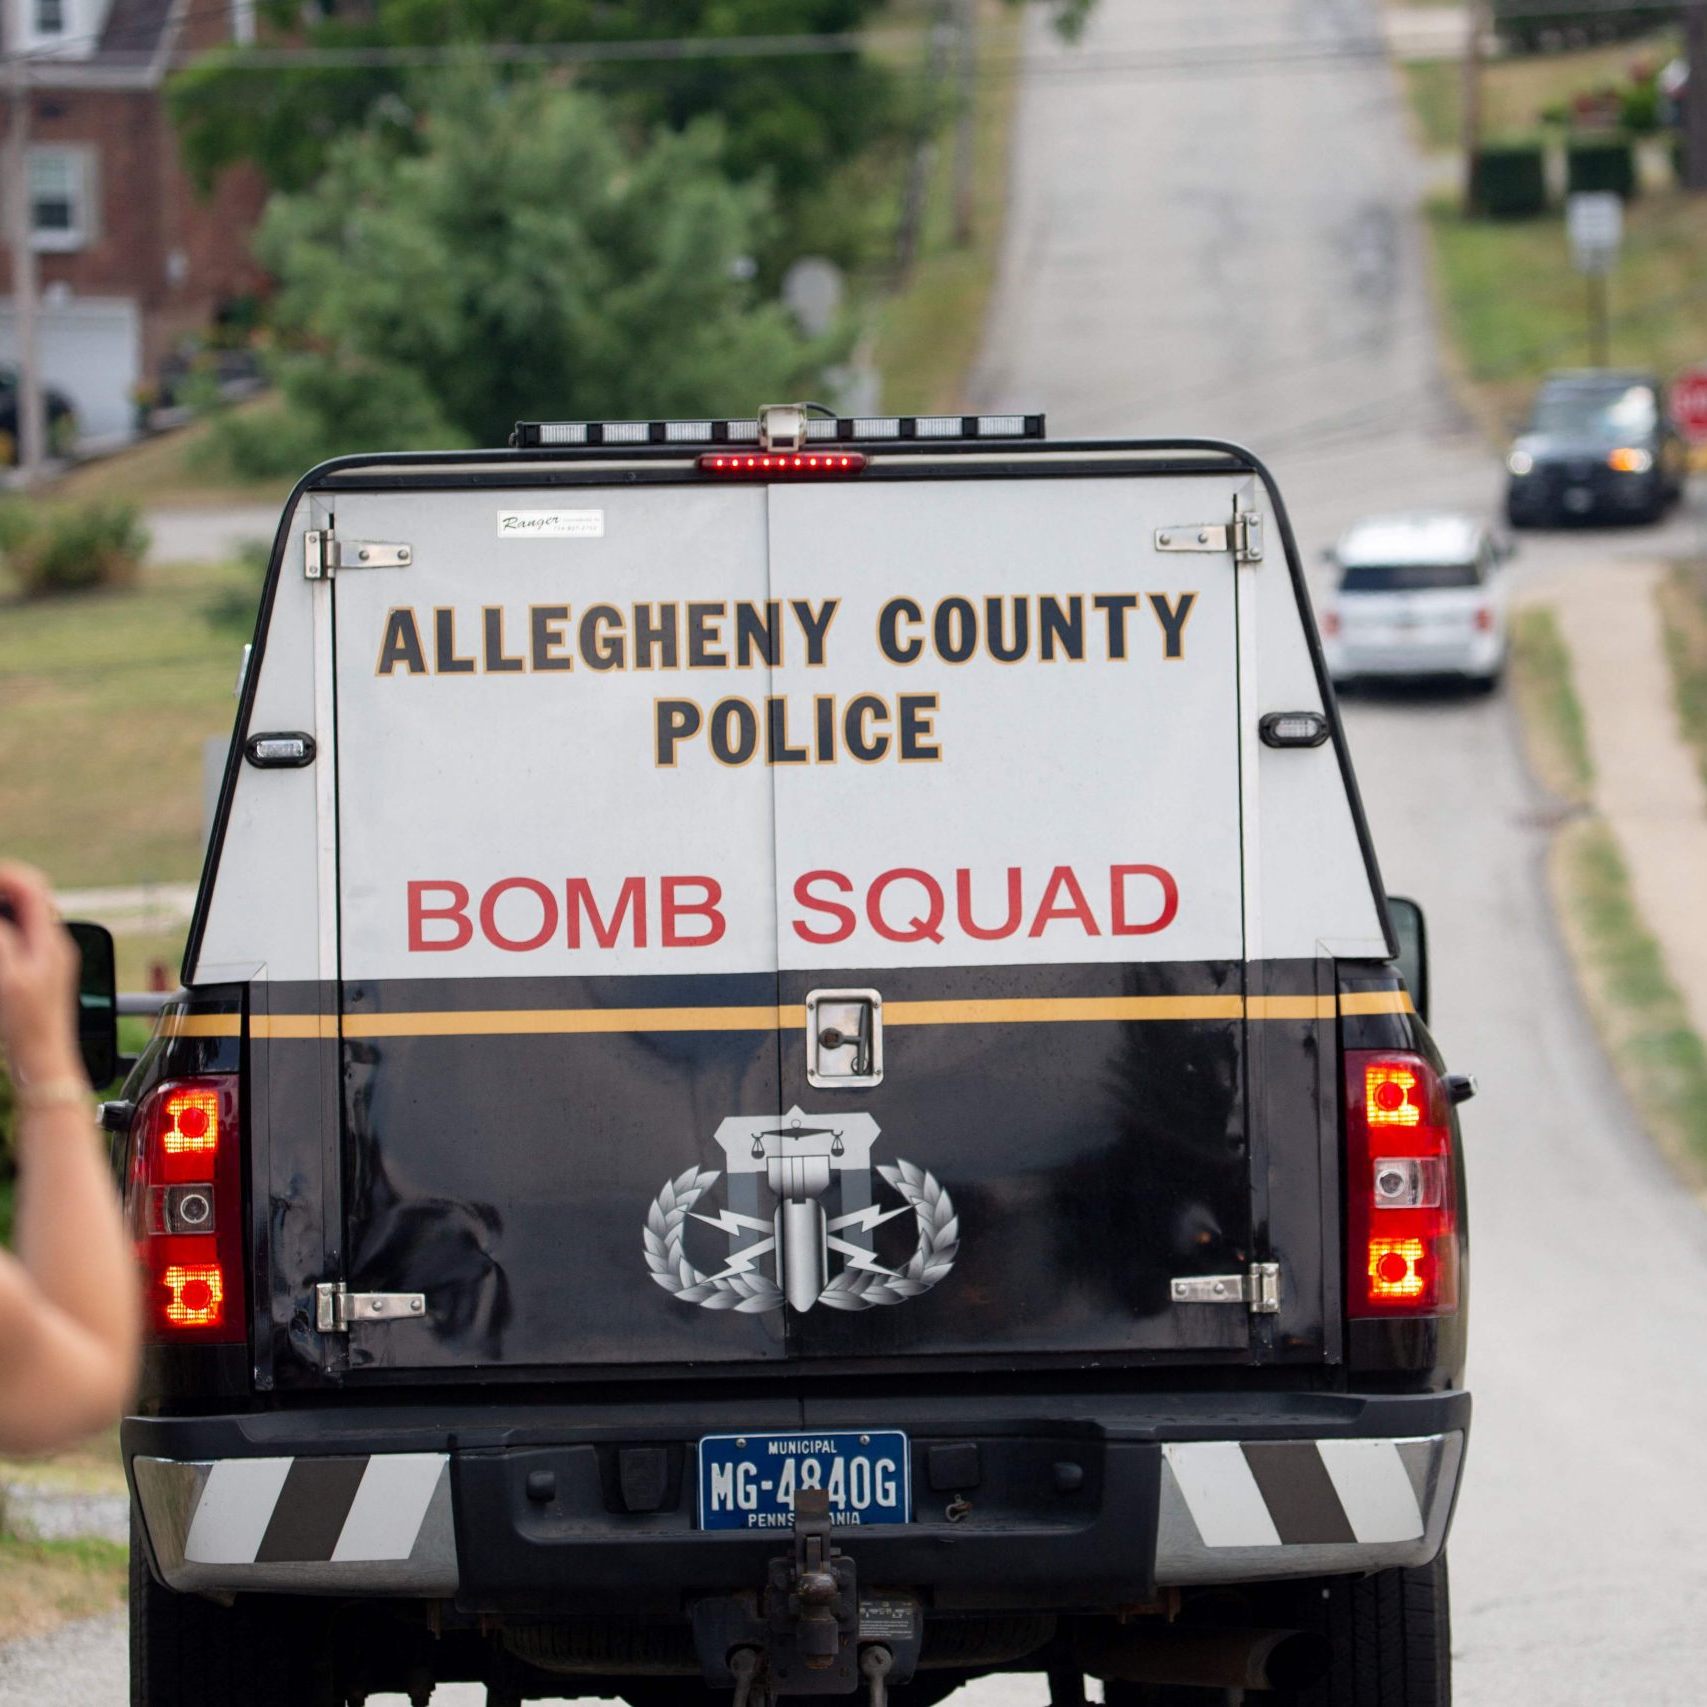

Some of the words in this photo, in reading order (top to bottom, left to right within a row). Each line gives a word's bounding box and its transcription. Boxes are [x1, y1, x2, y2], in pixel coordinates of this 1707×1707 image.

[502, 516, 560, 531] Ranger
[376, 598, 841, 676] ALLEGHENY
[876, 592, 1199, 666] COUNTY
[653, 691, 943, 768] POLICE
[408, 877, 725, 951] BOMB
[791, 865, 1178, 944] SQUAD
[768, 1439, 837, 1454] MUNICIPAL
